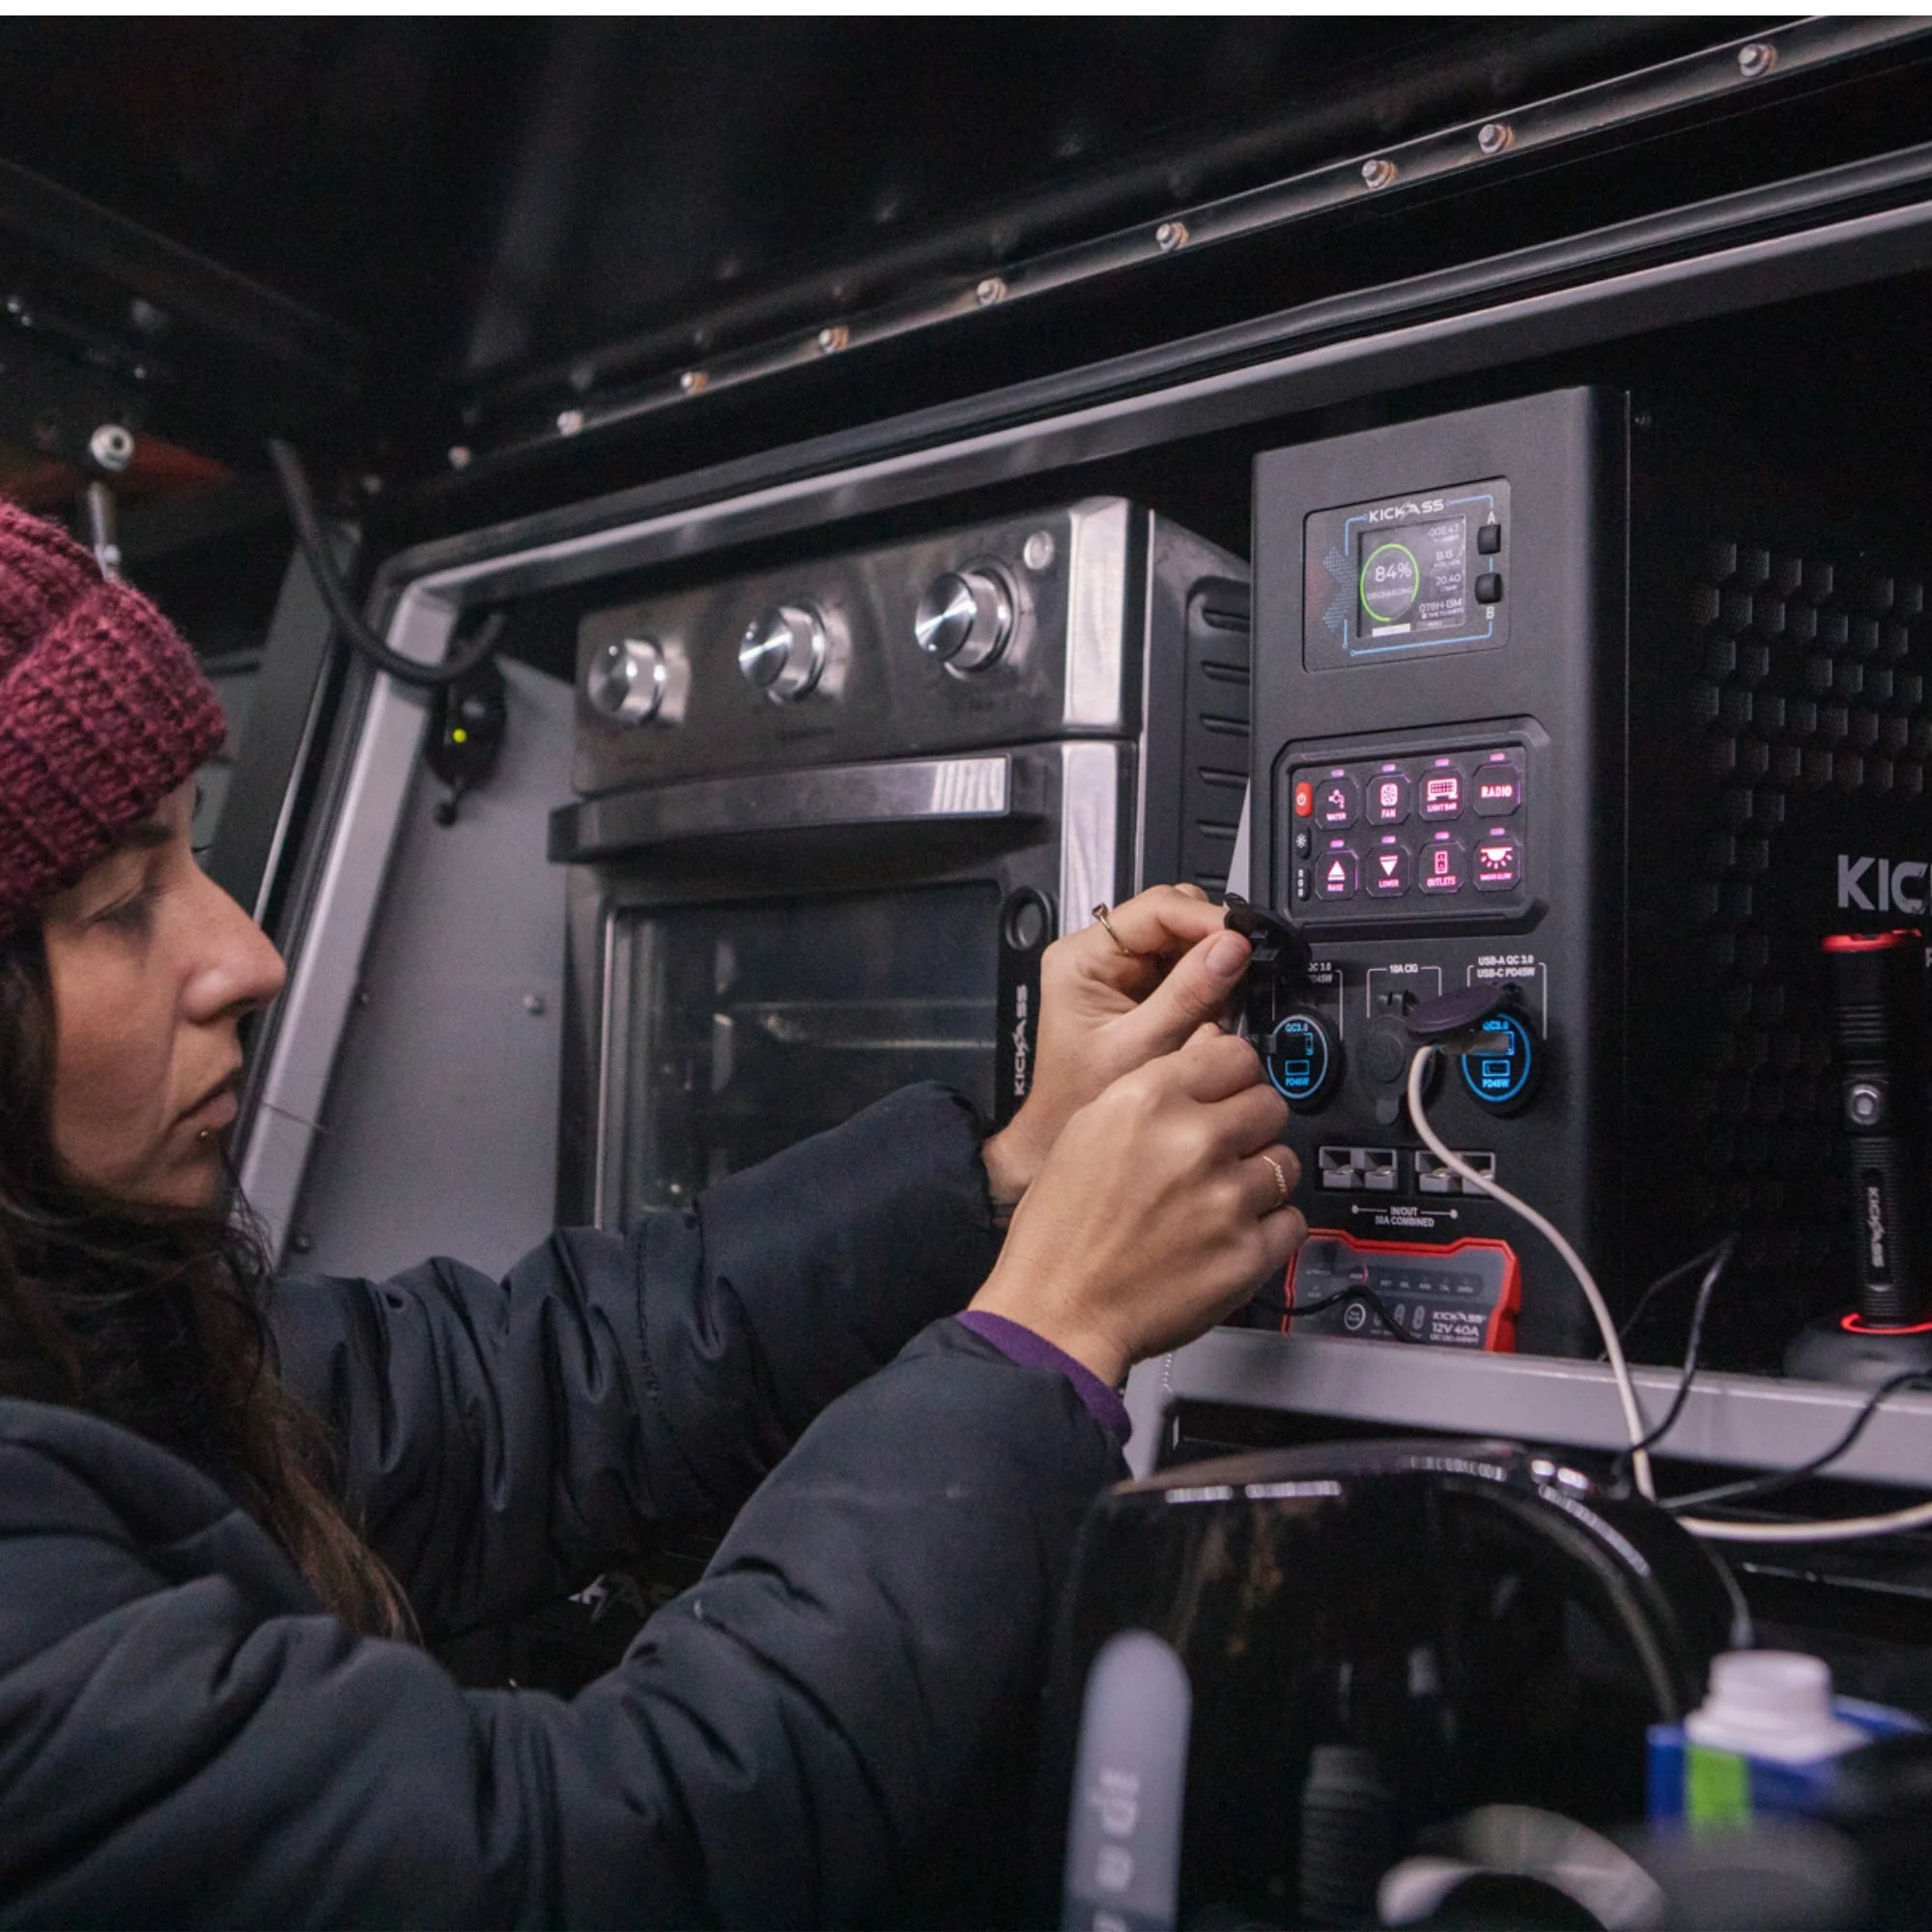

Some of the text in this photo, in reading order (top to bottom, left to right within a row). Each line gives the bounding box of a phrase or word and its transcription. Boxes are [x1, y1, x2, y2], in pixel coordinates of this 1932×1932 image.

[1368, 498, 1445, 523] KICKASS
[1486, 510, 1496, 524] A
[1375, 561, 1413, 582] 84%
[1486, 606, 1495, 619] B
[1480, 785, 1513, 798] RADIO
[1380, 809, 1396, 819] FAN
[1426, 875, 1457, 887] OUTLETS
[1837, 854, 1932, 915] KIC
[1478, 955, 1504, 965] USB-A
[1477, 968, 1503, 978] USB-C
[1012, 984, 1032, 1096] KICKASS
[1390, 1216, 1435, 1228] COMBINED
[1432, 1321, 1480, 1337] 12V 40A
